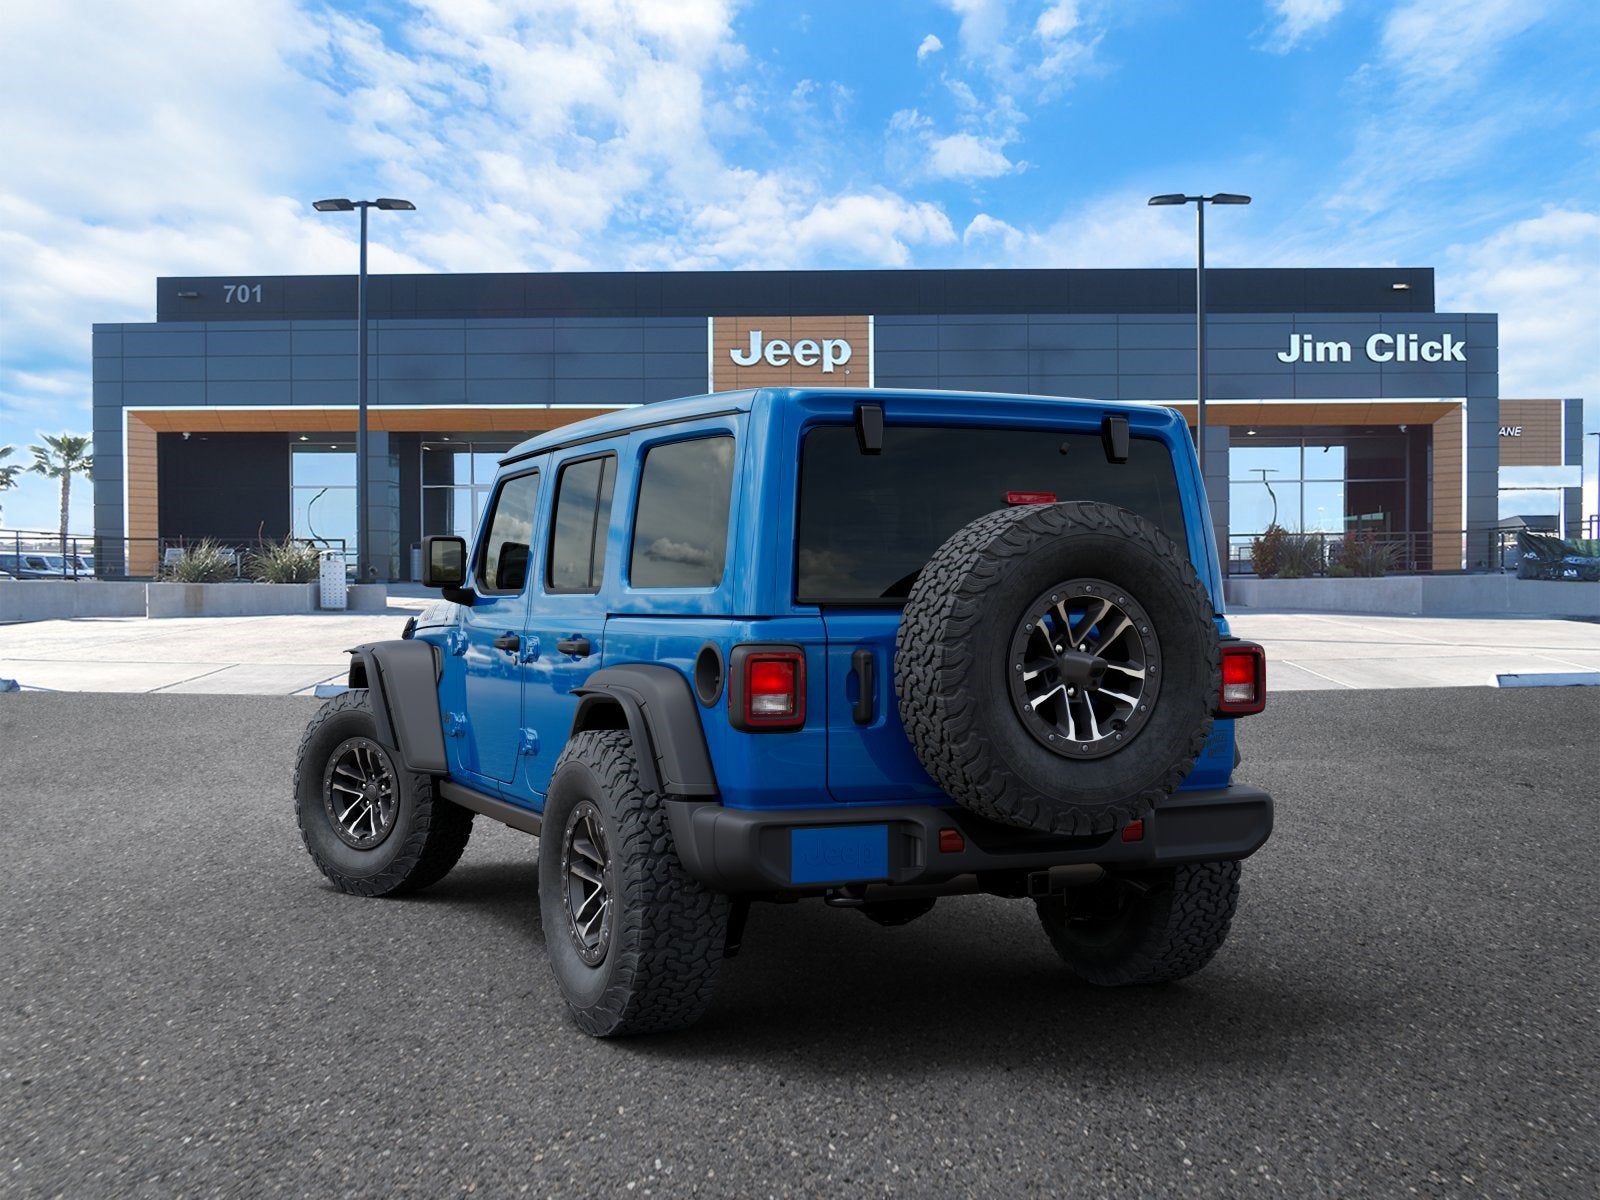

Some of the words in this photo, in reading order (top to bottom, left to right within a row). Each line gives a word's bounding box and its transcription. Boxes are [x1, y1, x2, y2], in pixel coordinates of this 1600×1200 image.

[223, 284, 262, 304] 701
[729, 329, 852, 373] Jeep
[1277, 333, 1351, 363] Jim
[1365, 333, 1467, 362] Click
[800, 837, 874, 870] Jeep
